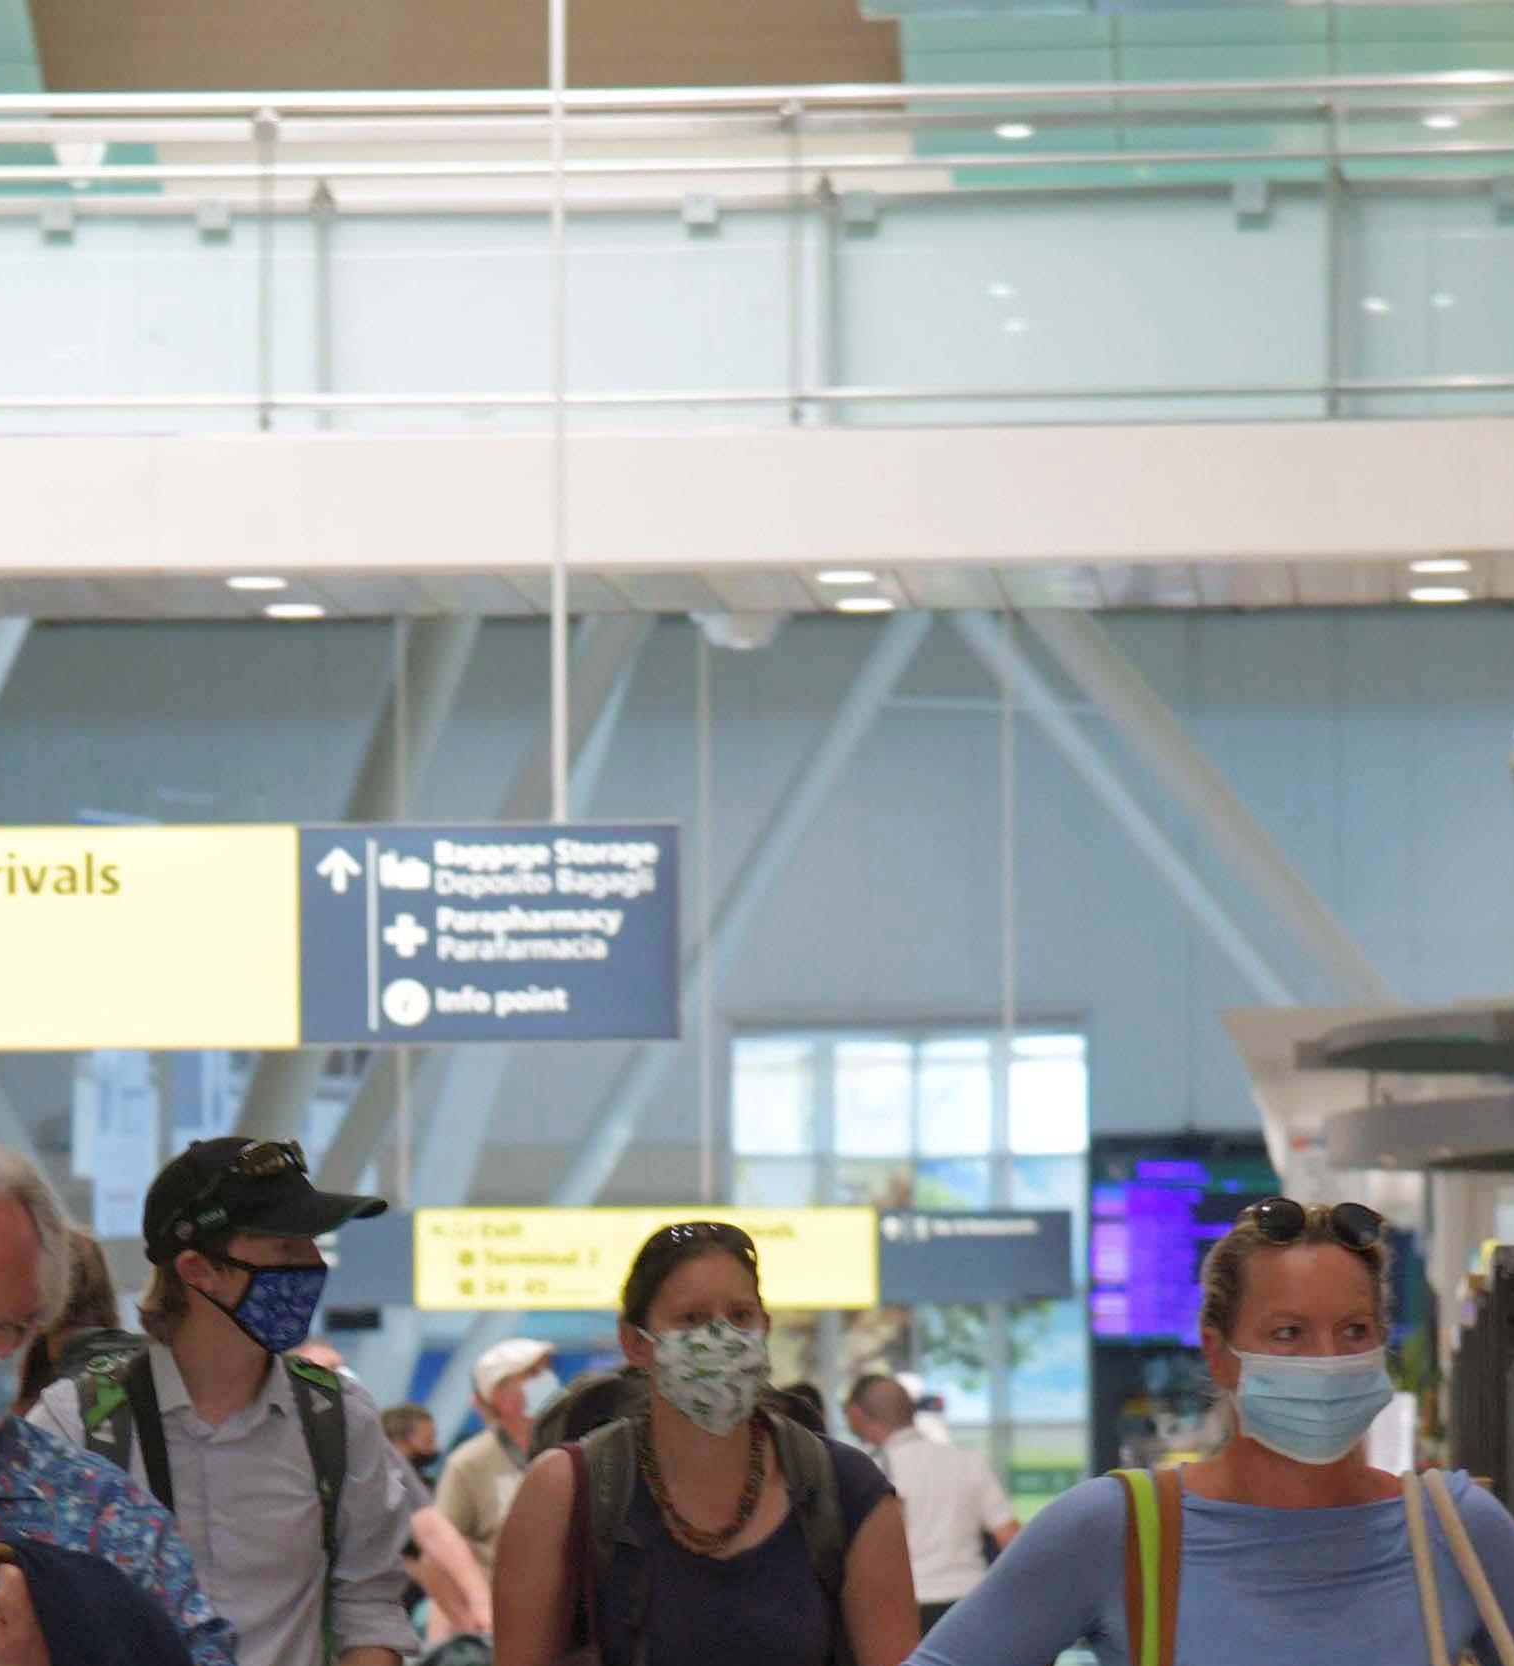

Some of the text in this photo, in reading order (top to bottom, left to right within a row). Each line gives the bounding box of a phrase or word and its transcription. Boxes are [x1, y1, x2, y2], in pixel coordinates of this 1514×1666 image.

[433, 838, 660, 872] Baggage Storage
[434, 866, 656, 900] Deposito Bagagli
[436, 905, 624, 937] Parapharmacy
[436, 934, 609, 961] Parafarmacia
[435, 984, 569, 1017] Info point
